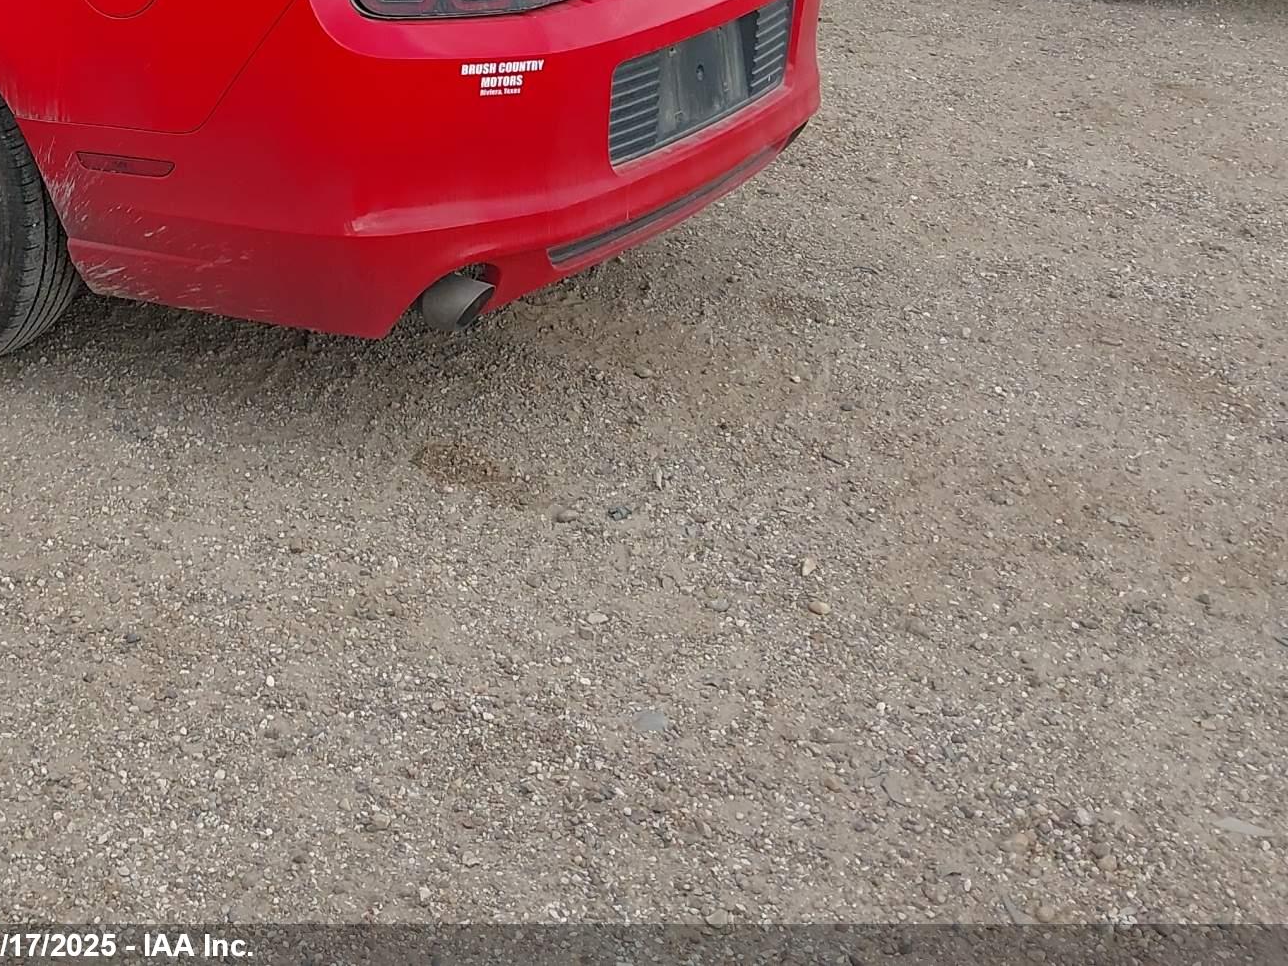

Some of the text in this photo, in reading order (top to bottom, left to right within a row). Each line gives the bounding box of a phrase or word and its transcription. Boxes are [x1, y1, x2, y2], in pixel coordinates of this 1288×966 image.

[461, 59, 545, 75] BRUSH COUNTRY
[480, 75, 523, 88] MOTORS
